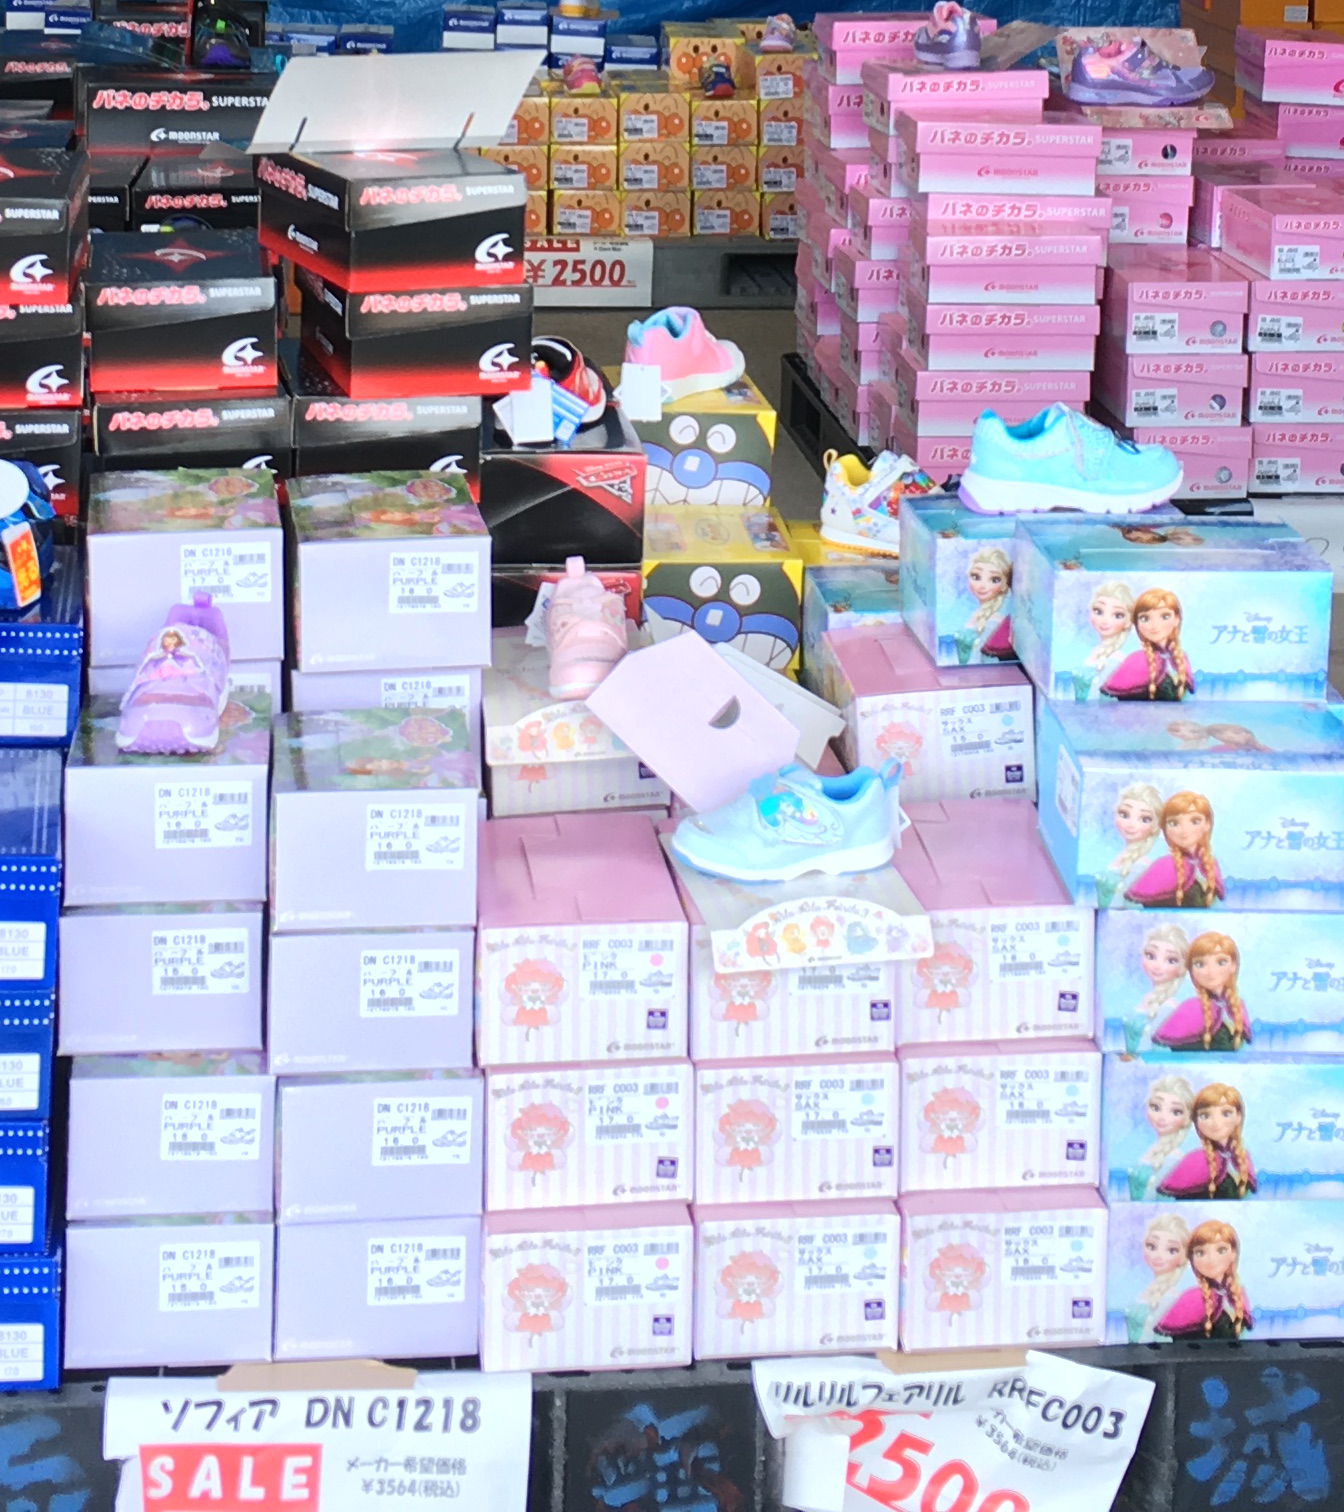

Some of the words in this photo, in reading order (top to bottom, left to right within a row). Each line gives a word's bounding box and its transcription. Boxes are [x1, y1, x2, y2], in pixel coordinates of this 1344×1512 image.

[5, 207, 59, 221] SUPERSTAR
[525, 257, 626, 287] ¥2500
[1209, 624, 1309, 646] アナと雪の女王
[772, 1381, 967, 1408] リルリルフェアリル
[160, 1395, 281, 1433] ソフィア
[303, 1396, 353, 1429] DN
[365, 1395, 483, 1434] C1218
[145, 1455, 316, 1502] SALE
[345, 1455, 468, 1476] メーカー希望価格
